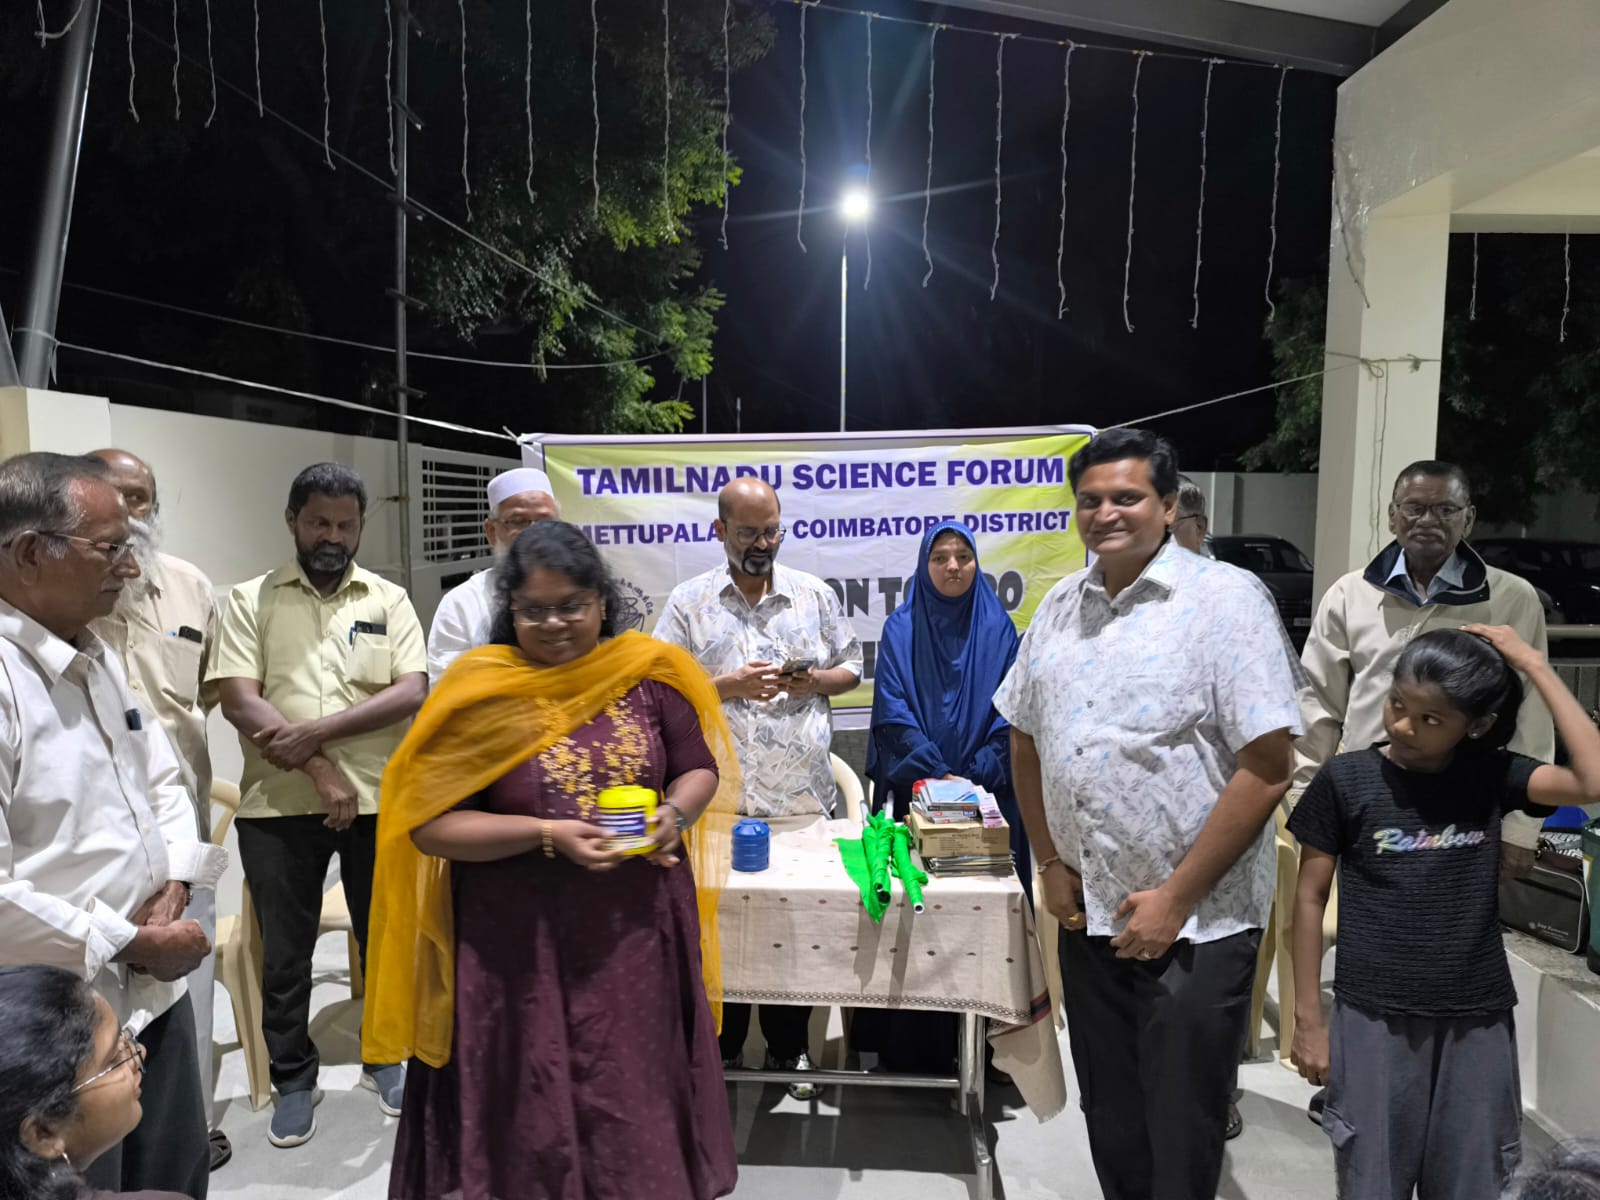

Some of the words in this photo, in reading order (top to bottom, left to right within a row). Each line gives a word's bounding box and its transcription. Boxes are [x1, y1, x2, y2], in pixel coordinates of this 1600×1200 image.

[792, 461, 937, 490] SCIENCE
[947, 457, 1064, 486] FORUM
[963, 510, 1071, 534] DISTRICT
